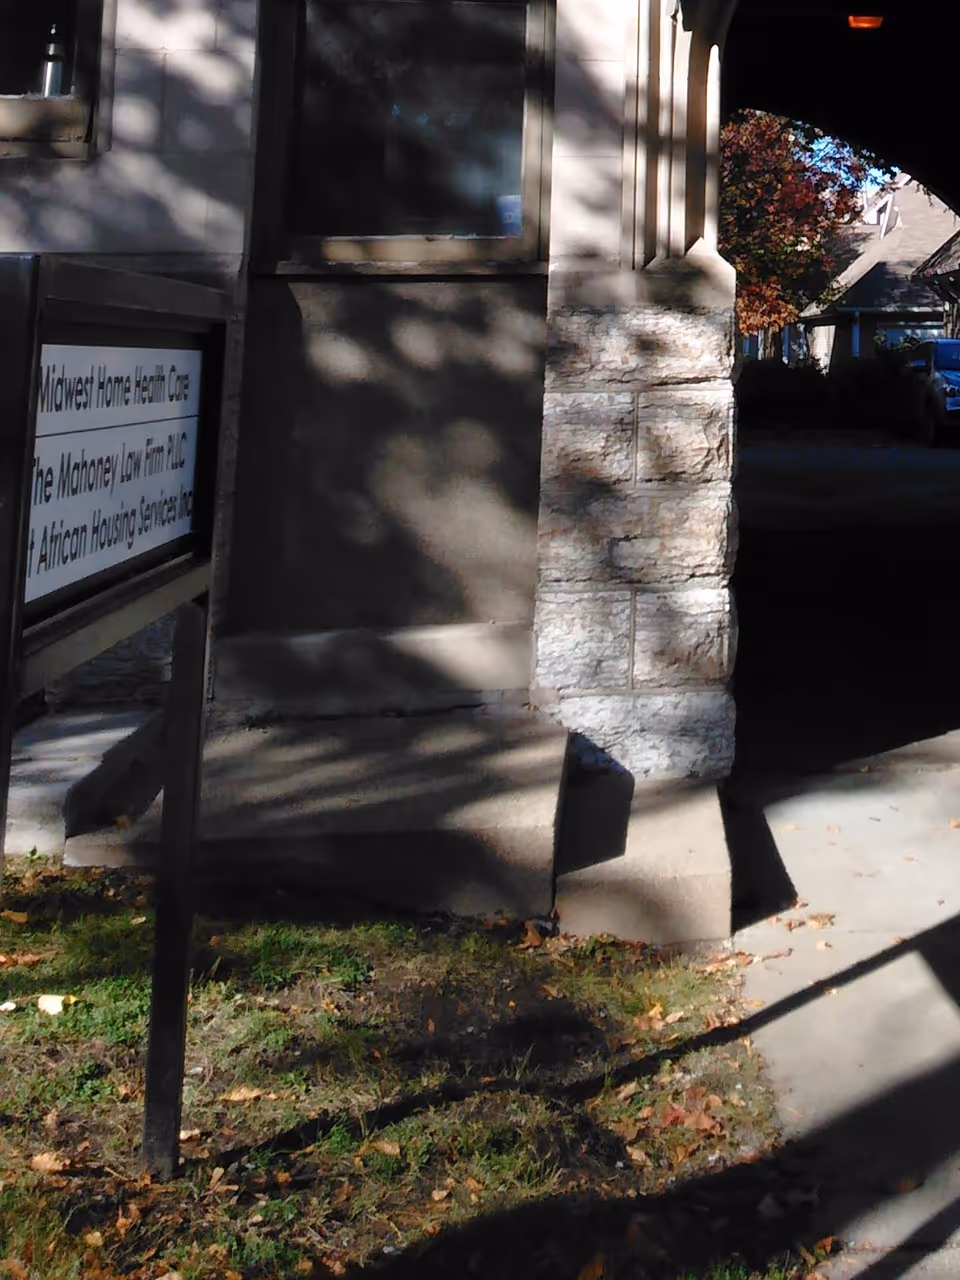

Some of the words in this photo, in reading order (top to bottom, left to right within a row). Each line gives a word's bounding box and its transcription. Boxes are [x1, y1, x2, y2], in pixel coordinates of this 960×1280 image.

[38, 364, 94, 413] Midwest
[96, 365, 131, 408] Home
[134, 364, 166, 404] Health
[168, 364, 189, 402] Care
[57, 448, 118, 499] Mahoney
[120, 443, 143, 483] Law
[144, 437, 164, 477] Firm
[166, 432, 187, 470] PLLC
[36, 519, 88, 575] African
[91, 501, 136, 550] Housing
[138, 489, 177, 536] Services
